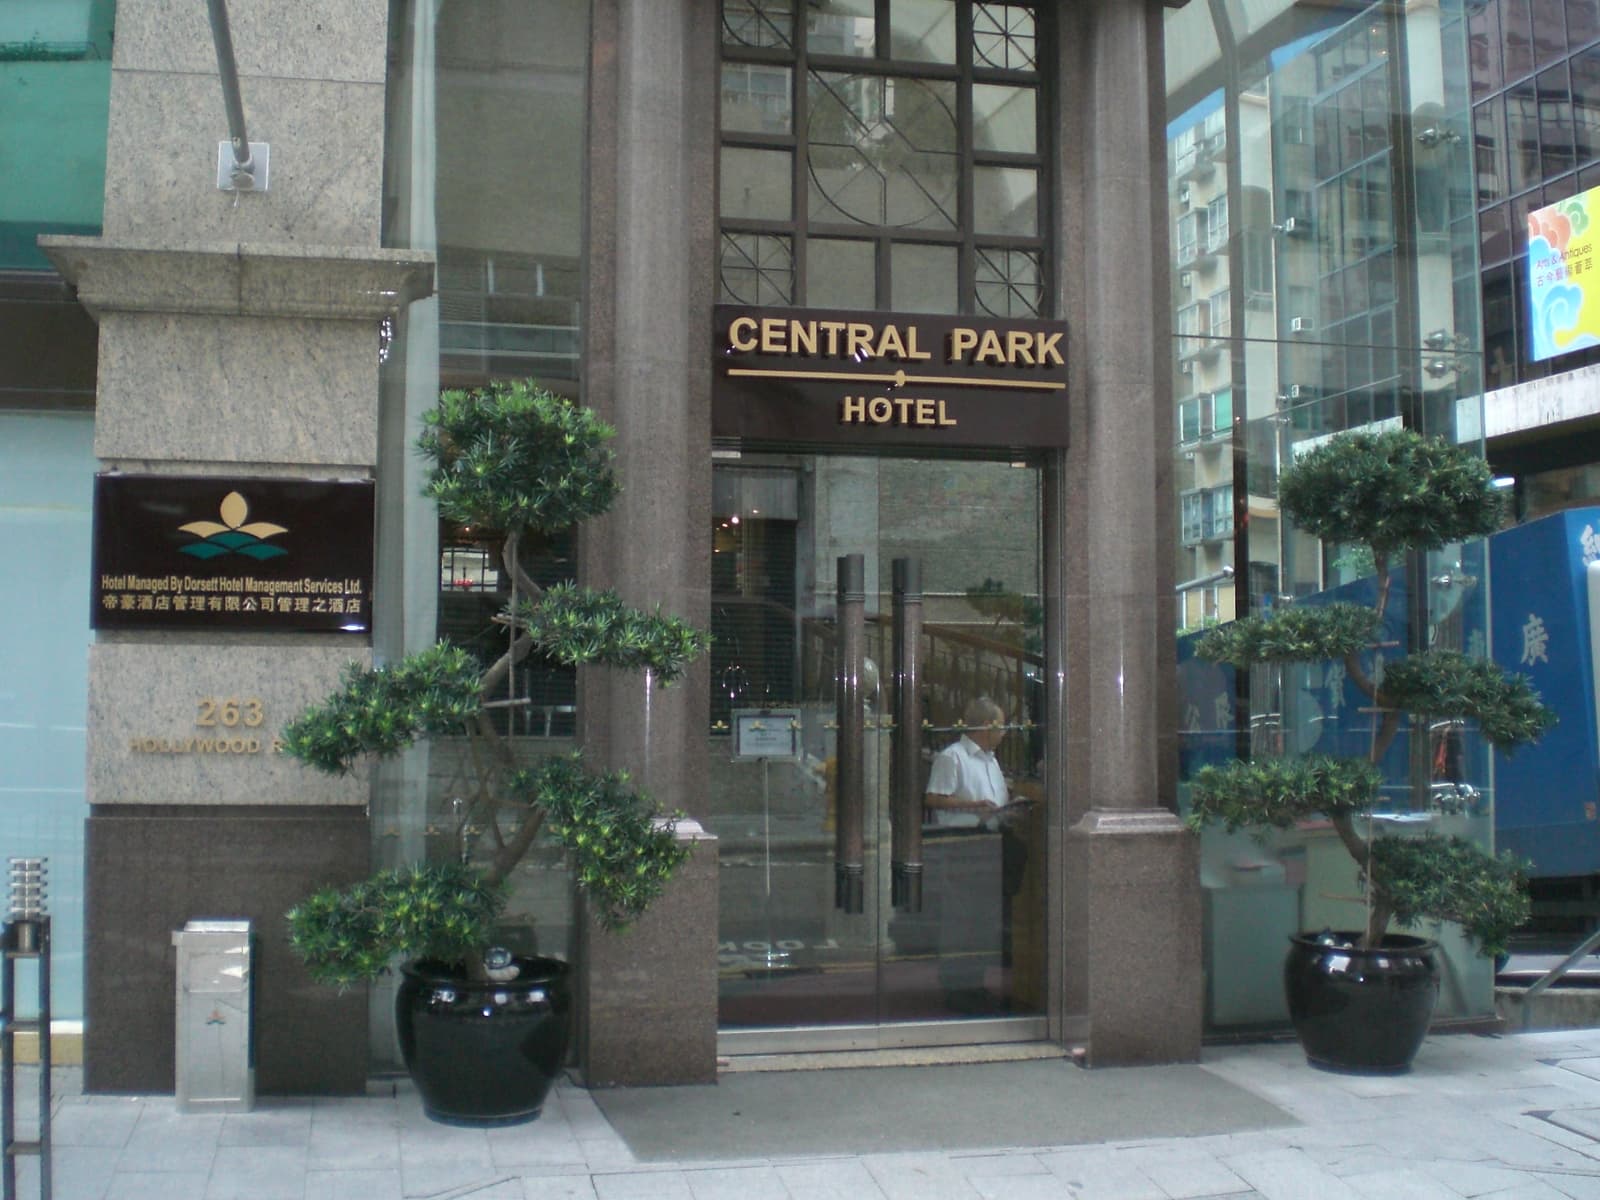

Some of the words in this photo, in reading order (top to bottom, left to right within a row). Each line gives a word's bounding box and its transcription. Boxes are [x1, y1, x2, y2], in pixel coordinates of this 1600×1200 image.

[1559, 243, 1593, 262] Antiques
[729, 316, 932, 361] CENTRAL
[952, 327, 1065, 366] PARK
[843, 395, 957, 426] HOTEL
[102, 575, 126, 590] Hotel
[127, 575, 169, 594] Managed
[170, 576, 183, 594] By
[184, 576, 219, 591] Dorsett
[220, 577, 243, 592] Hotel
[245, 577, 303, 596] Management
[304, 578, 343, 594] Services
[345, 579, 362, 594] Ltd.
[195, 698, 265, 727] 263
[128, 736, 261, 753] HOLLYWOOD
